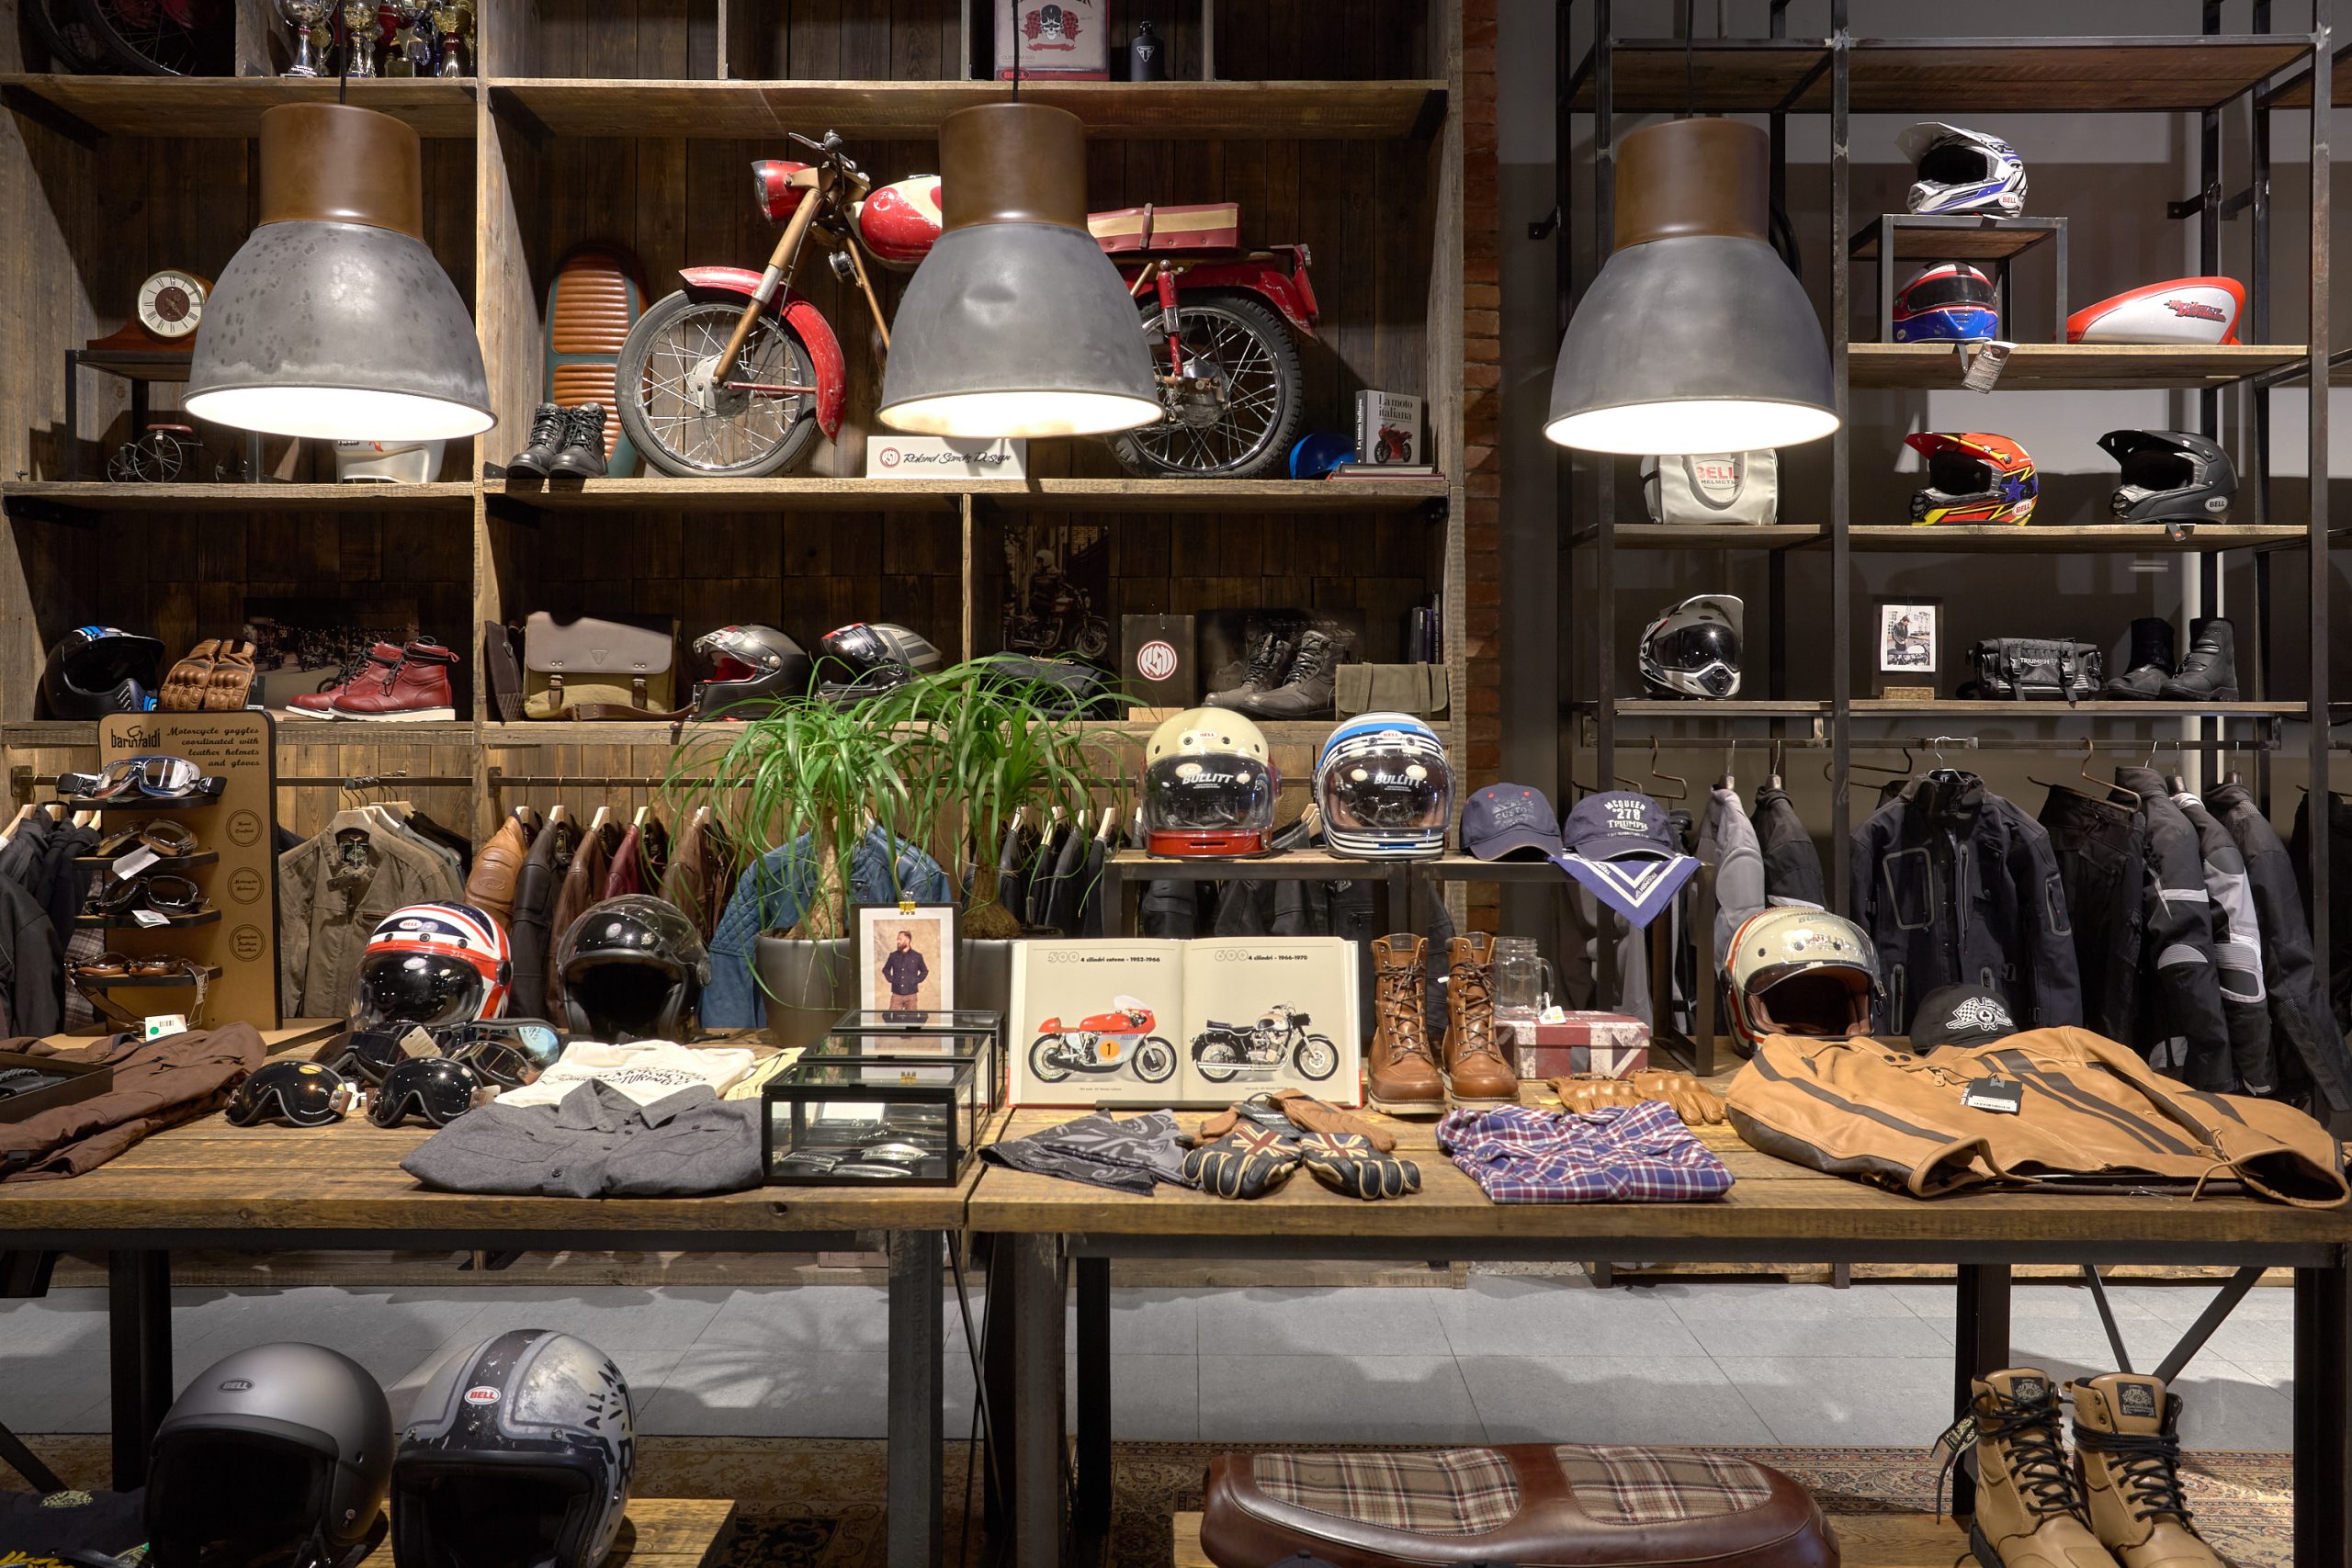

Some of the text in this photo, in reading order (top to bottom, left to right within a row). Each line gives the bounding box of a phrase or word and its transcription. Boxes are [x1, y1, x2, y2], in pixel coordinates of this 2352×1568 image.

[1391, 399, 1413, 410] moto
[1378, 406, 1412, 421] italiana
[903, 452, 1011, 465] Roland Sands Design
[1696, 467, 1739, 479] BELL
[2016, 503, 2030, 513] BELL
[2019, 657, 2050, 667] TRIUMPH
[166, 727, 259, 736] Motorcycle goggles
[231, 760, 260, 768] gloves
[1182, 773, 1234, 785] BULLITT
[1374, 773, 1423, 787] BULLITT
[1606, 819, 1648, 832] TRIUMPH
[1047, 951, 1080, 963] 500
[1215, 949, 1249, 962] 600
[1106, 1043, 1112, 1056] 1
[221, 1382, 249, 1390] BELL
[469, 1391, 495, 1399] BELL
